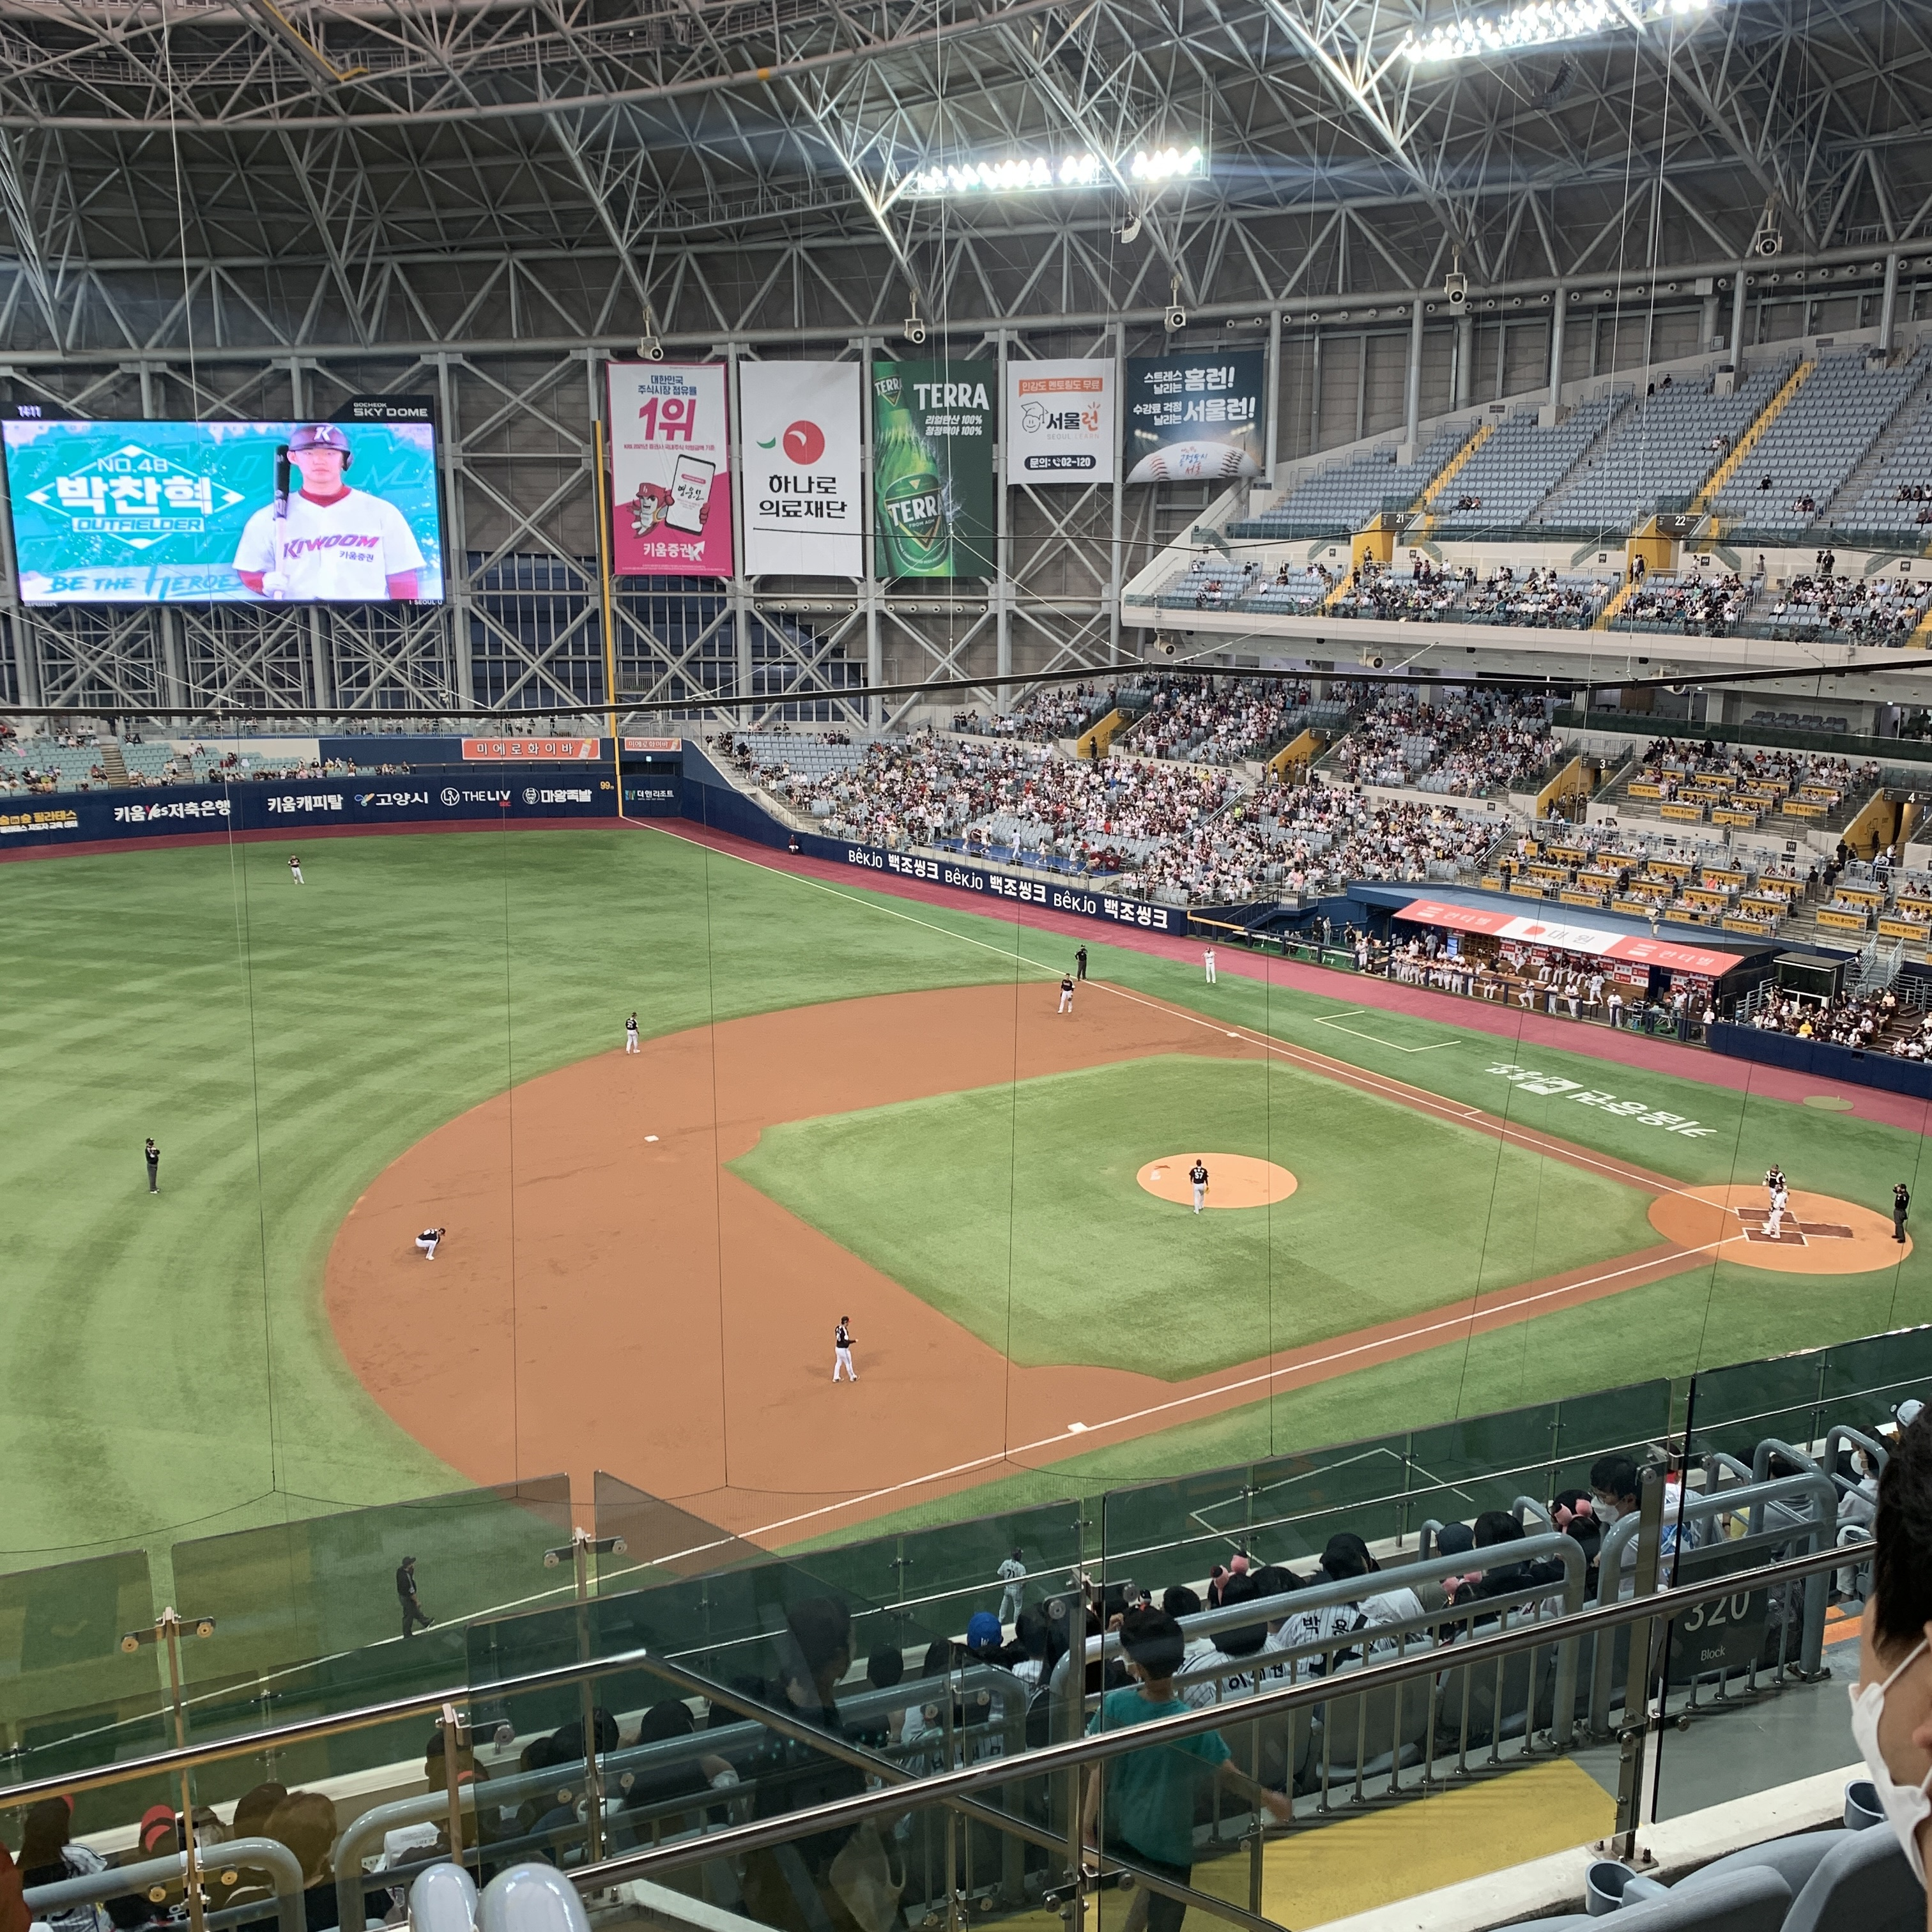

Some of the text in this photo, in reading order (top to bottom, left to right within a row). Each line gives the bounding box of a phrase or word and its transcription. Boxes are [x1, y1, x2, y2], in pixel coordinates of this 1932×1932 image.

[650, 375, 684, 385] 대한민국
[1084, 380, 1100, 390] 무료
[1144, 367, 1235, 392] 스트레스 홈런!
[638, 385, 697, 395] 주식시장 점유율
[1153, 383, 1182, 395] 날리는
[913, 383, 990, 410] TERRA
[353, 408, 428, 417] SKY DOME
[1133, 397, 1255, 422] 수강료 걱정 서울런!
[639, 397, 696, 441] 1위
[925, 415, 983, 425] 리얼탄산 100%
[1046, 410, 1098, 431] 서울런
[1154, 413, 1182, 426] 날리는
[961, 426, 982, 436] 100%
[97, 458, 169, 473] NO.48
[1030, 457, 1091, 468] 문의: 02-120
[769, 475, 836, 494] 하나로
[56, 475, 215, 515] 박찬혁
[759, 500, 847, 519] 의료재단
[77, 518, 202, 531] OUTFIELDER
[1396, 514, 1404, 523] 21
[1675, 516, 1686, 526] 22
[283, 534, 380, 560] KIWOOM
[643, 542, 692, 558] 키움증권
[339, 551, 374, 563] 키움증권
[44, 576, 87, 594] BE
[93, 577, 135, 590] THE
[1326, 731, 1331, 740] 2
[476, 742, 574, 755] 미에로화이바
[1600, 759, 1606, 769] 3
[376, 792, 428, 806] 고양시
[462, 791, 486, 802] THE
[487, 790, 511, 801] LIV
[540, 789, 592, 802] 마왕족발
[1908, 792, 1915, 803] 4
[268, 794, 343, 813] 키움캐피탈
[114, 800, 231, 822] 키움Yes저축은행
[888, 853, 939, 880] 백조씽크
[990, 874, 1046, 903] 백조씽크
[1104, 898, 1168, 929] 백조씽크
[1547, 930, 1595, 945] 대원
[1684, 1591, 1749, 1632] 320
[1701, 1646, 1726, 1661] Block
